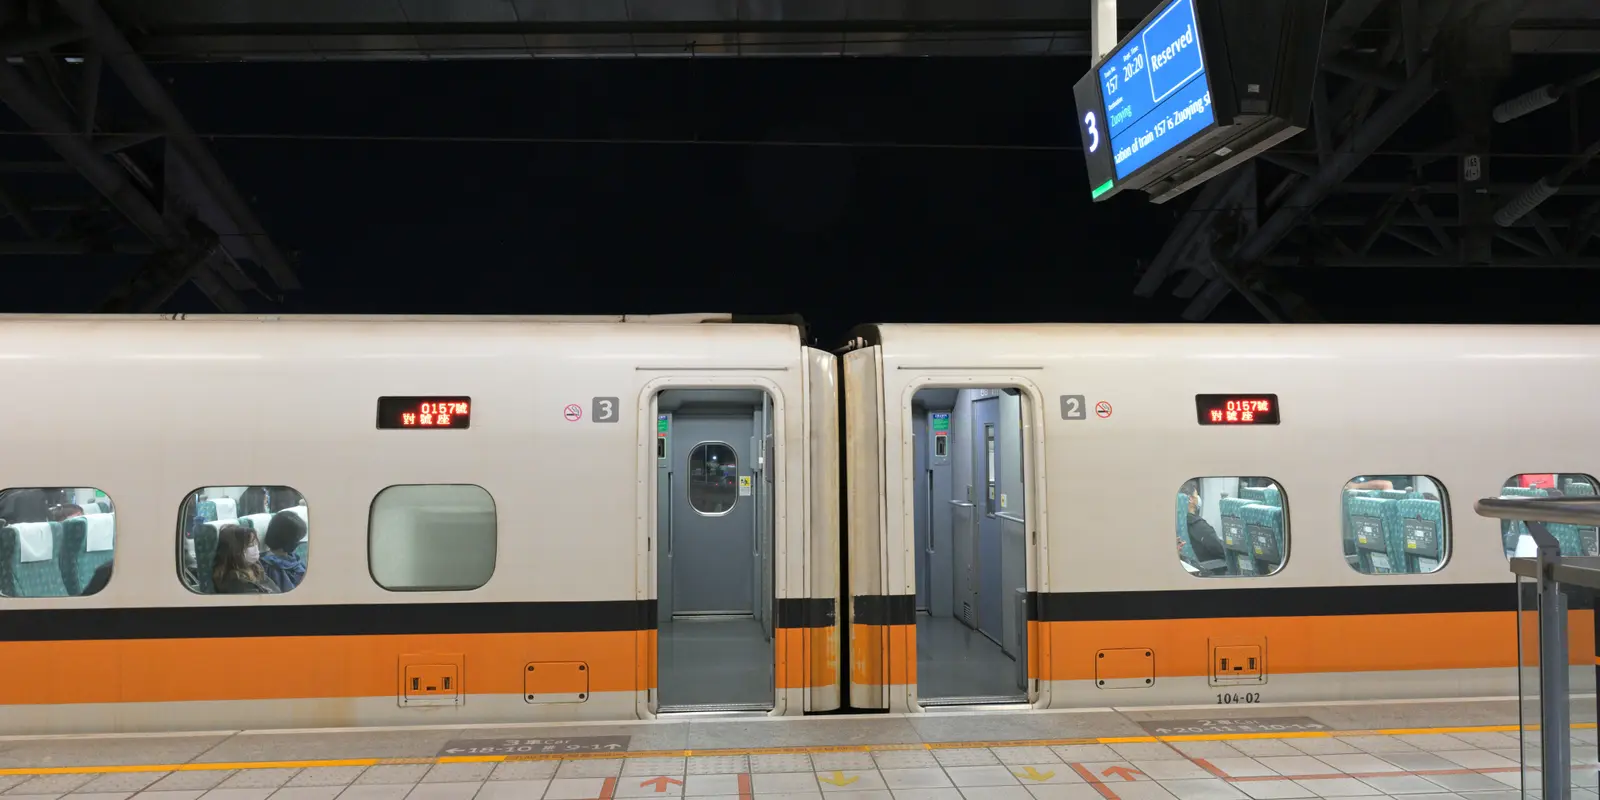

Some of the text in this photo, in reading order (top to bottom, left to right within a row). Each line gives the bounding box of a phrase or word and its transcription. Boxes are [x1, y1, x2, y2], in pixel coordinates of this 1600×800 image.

[1151, 24, 1193, 72] Reserved
[1123, 53, 1143, 82] 20:20
[1106, 74, 1118, 95] 157
[1110, 105, 1132, 127] Zuoying
[1131, 137, 1139, 153] of
[1138, 130, 1154, 148] train
[1154, 119, 1166, 138] 157
[1166, 116, 1175, 130] is
[1173, 98, 1205, 126] Zuoying
[1084, 111, 1099, 152] 3
[421, 402, 468, 414] 0157號
[598, 400, 613, 420] 3
[1066, 397, 1080, 417] 2
[1227, 400, 1269, 411] 0157號
[1216, 693, 1261, 704] 104-02
